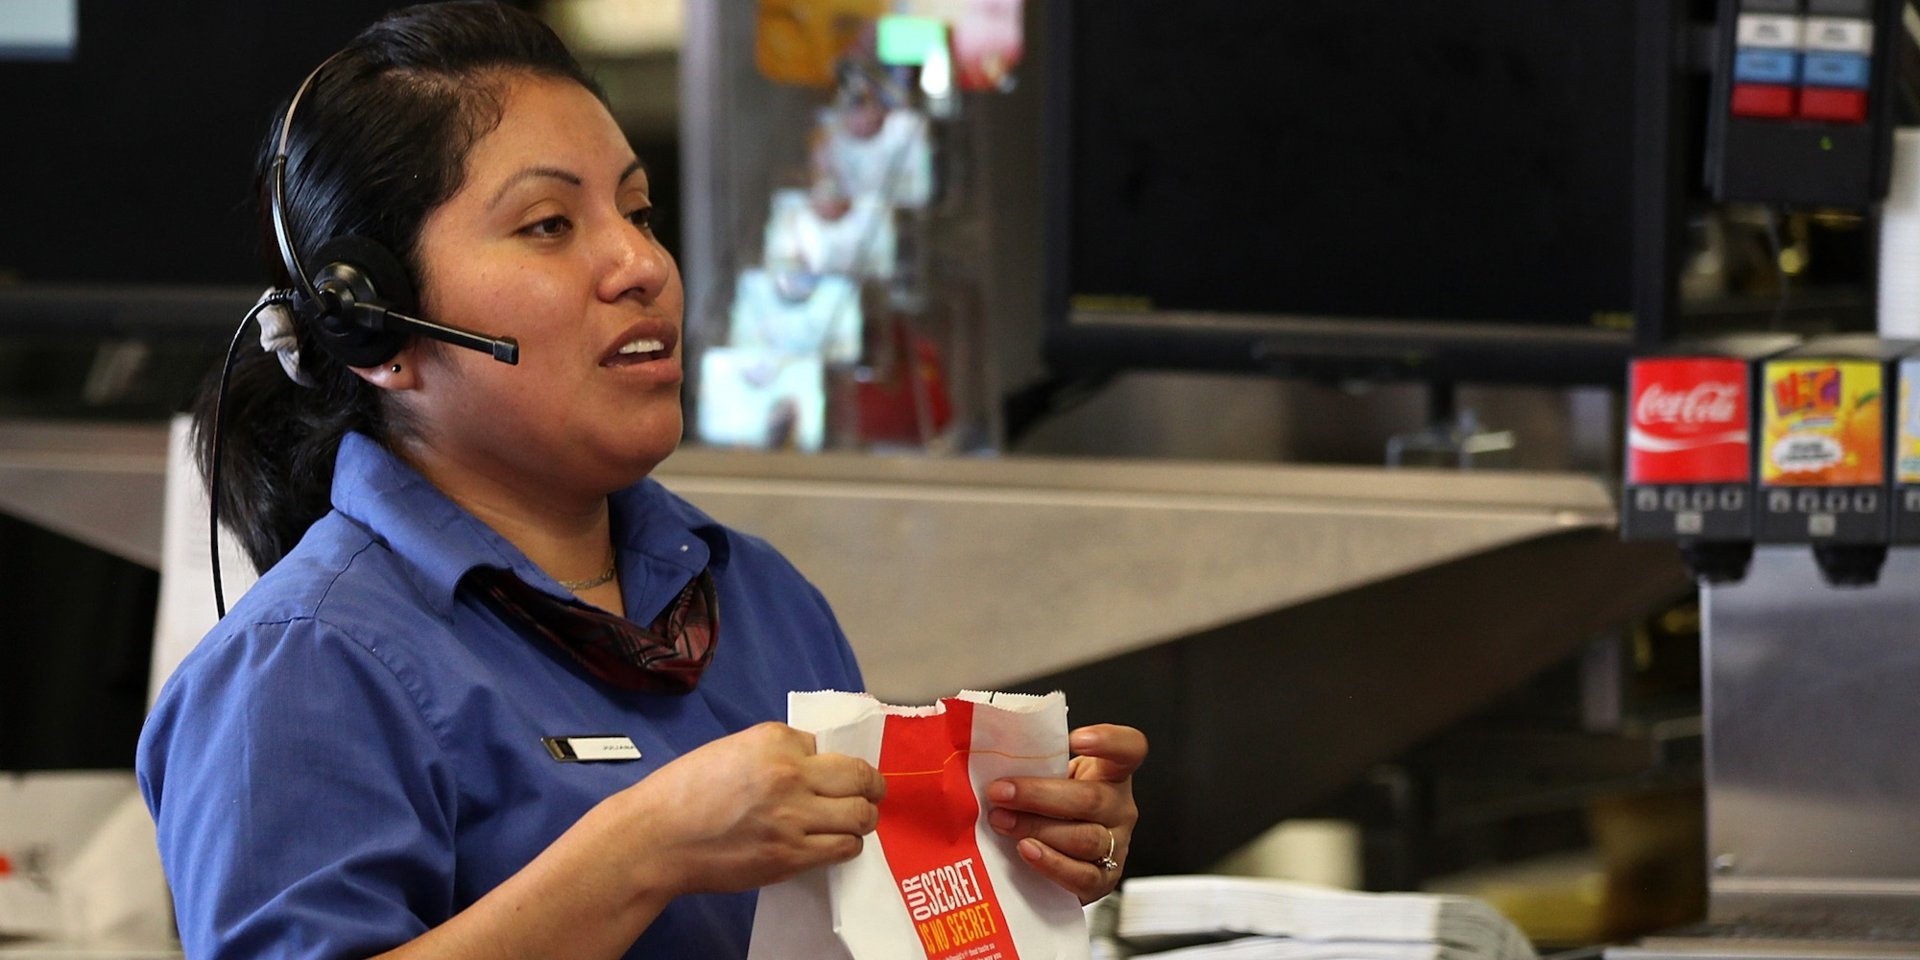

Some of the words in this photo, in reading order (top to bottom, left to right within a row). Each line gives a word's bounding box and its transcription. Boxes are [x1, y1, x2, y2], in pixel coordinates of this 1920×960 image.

[1637, 381, 1739, 424] Coca-Cola
[902, 875, 931, 921] OUR
[921, 858, 983, 915] SECRET
[919, 922, 936, 954] IS
[929, 919, 950, 953] NO
[946, 902, 997, 947] SECRET
